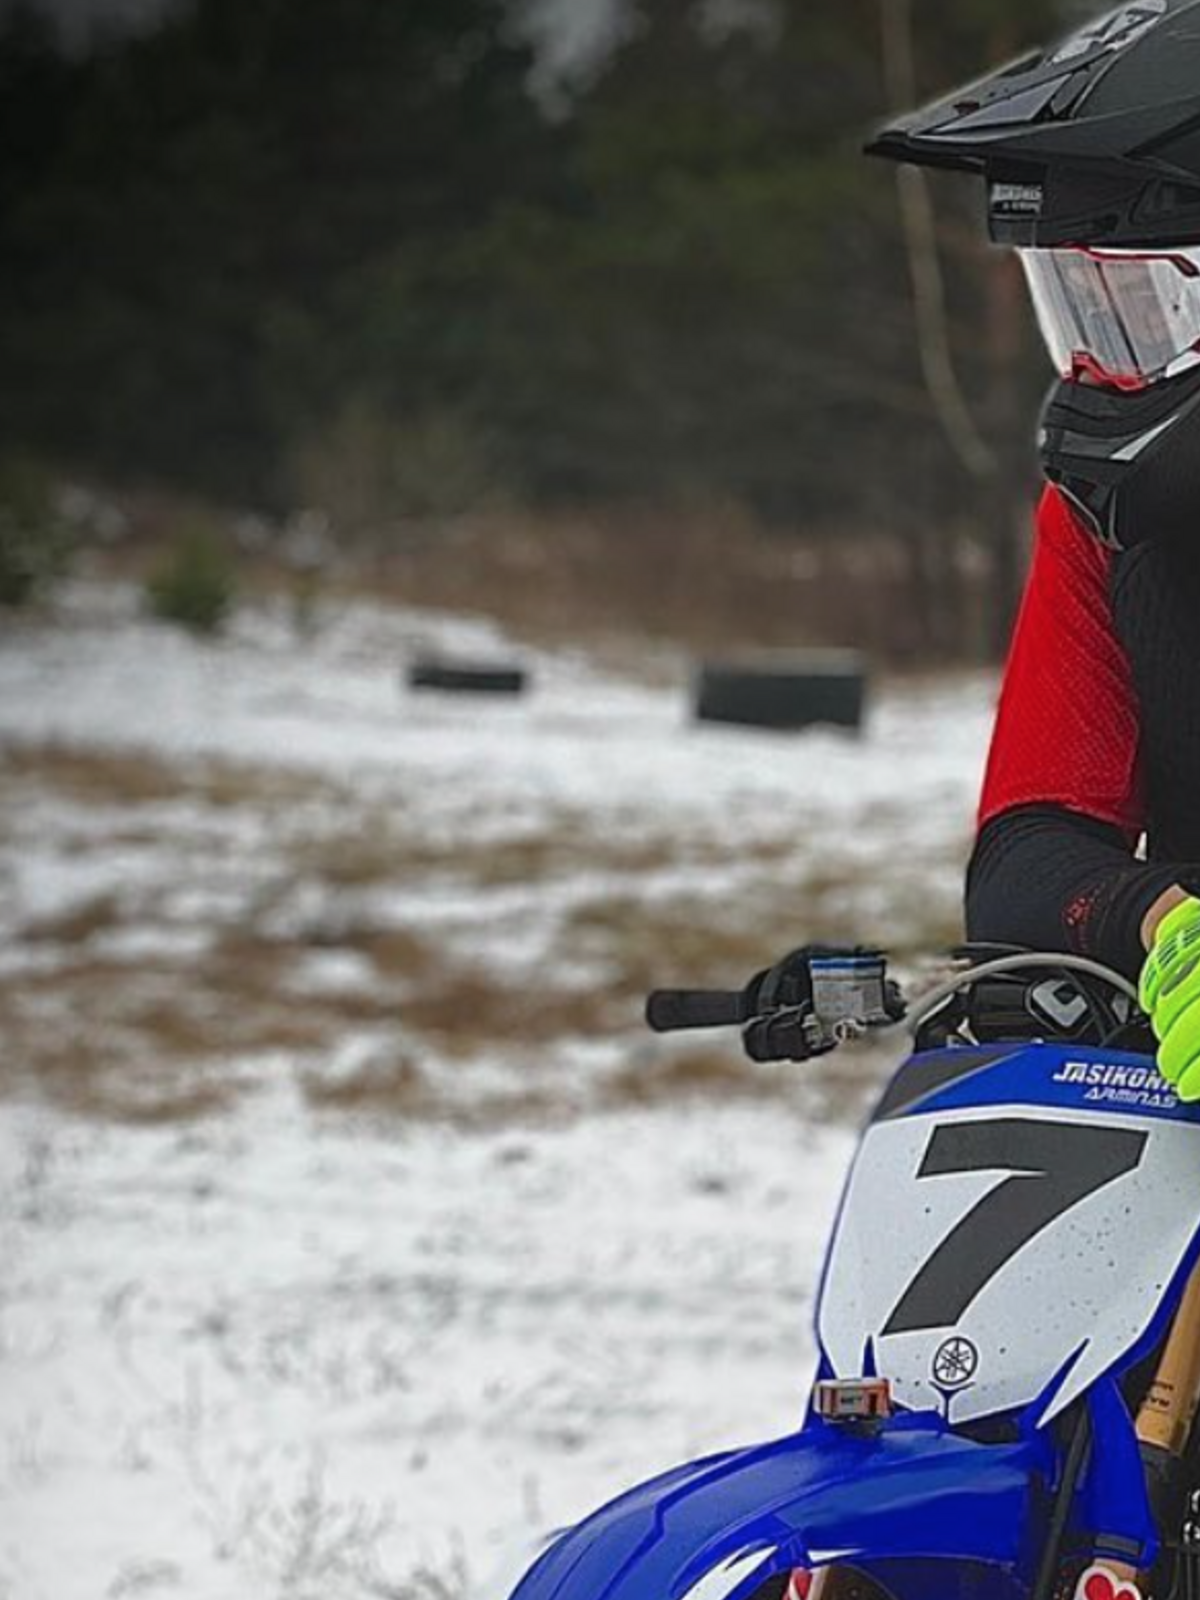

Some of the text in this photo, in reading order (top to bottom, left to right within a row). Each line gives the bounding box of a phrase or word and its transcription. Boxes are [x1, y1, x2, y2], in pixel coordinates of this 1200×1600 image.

[1053, 1063, 1178, 1093] JASIKONI
[1085, 1086, 1178, 1108] ARMINAS
[879, 1117, 1150, 1337] 7
